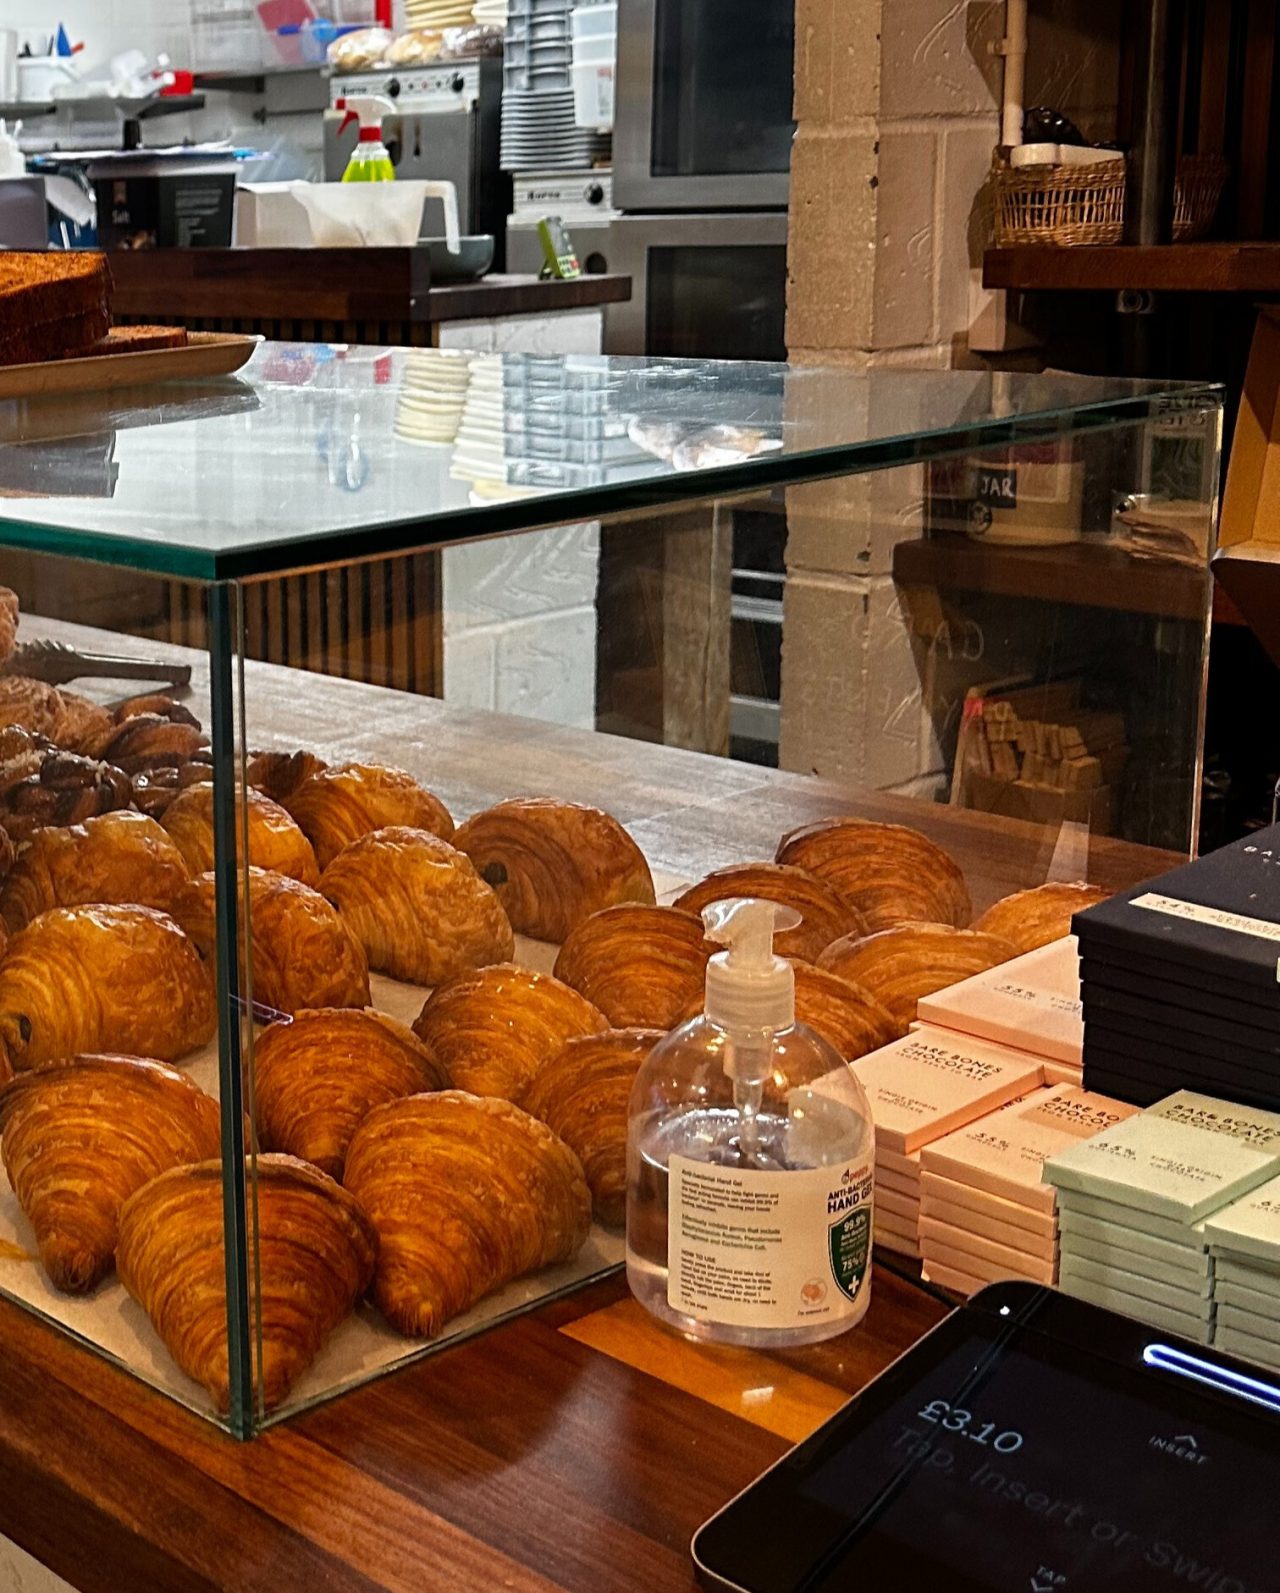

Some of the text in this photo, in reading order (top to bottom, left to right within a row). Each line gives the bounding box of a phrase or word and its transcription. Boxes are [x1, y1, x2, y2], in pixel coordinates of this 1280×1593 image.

[980, 476, 1016, 498] JAR
[901, 1047, 993, 1078] CHOCOLATE
[910, 1042, 1003, 1074] BARE BONES
[1044, 1102, 1111, 1129] CHOCOL
[1051, 1096, 1093, 1113] BARE
[1173, 1104, 1218, 1120] BARE
[1165, 1110, 1275, 1143] CHOCOLATE
[827, 1191, 859, 1214] HAND
[917, 1399, 1024, 1453] £3.10
[1148, 1435, 1208, 1465] INSERT
[969, 1462, 1087, 1528] Insert
[1090, 1520, 1140, 1547] or
[1035, 1564, 1067, 1585] TAP
